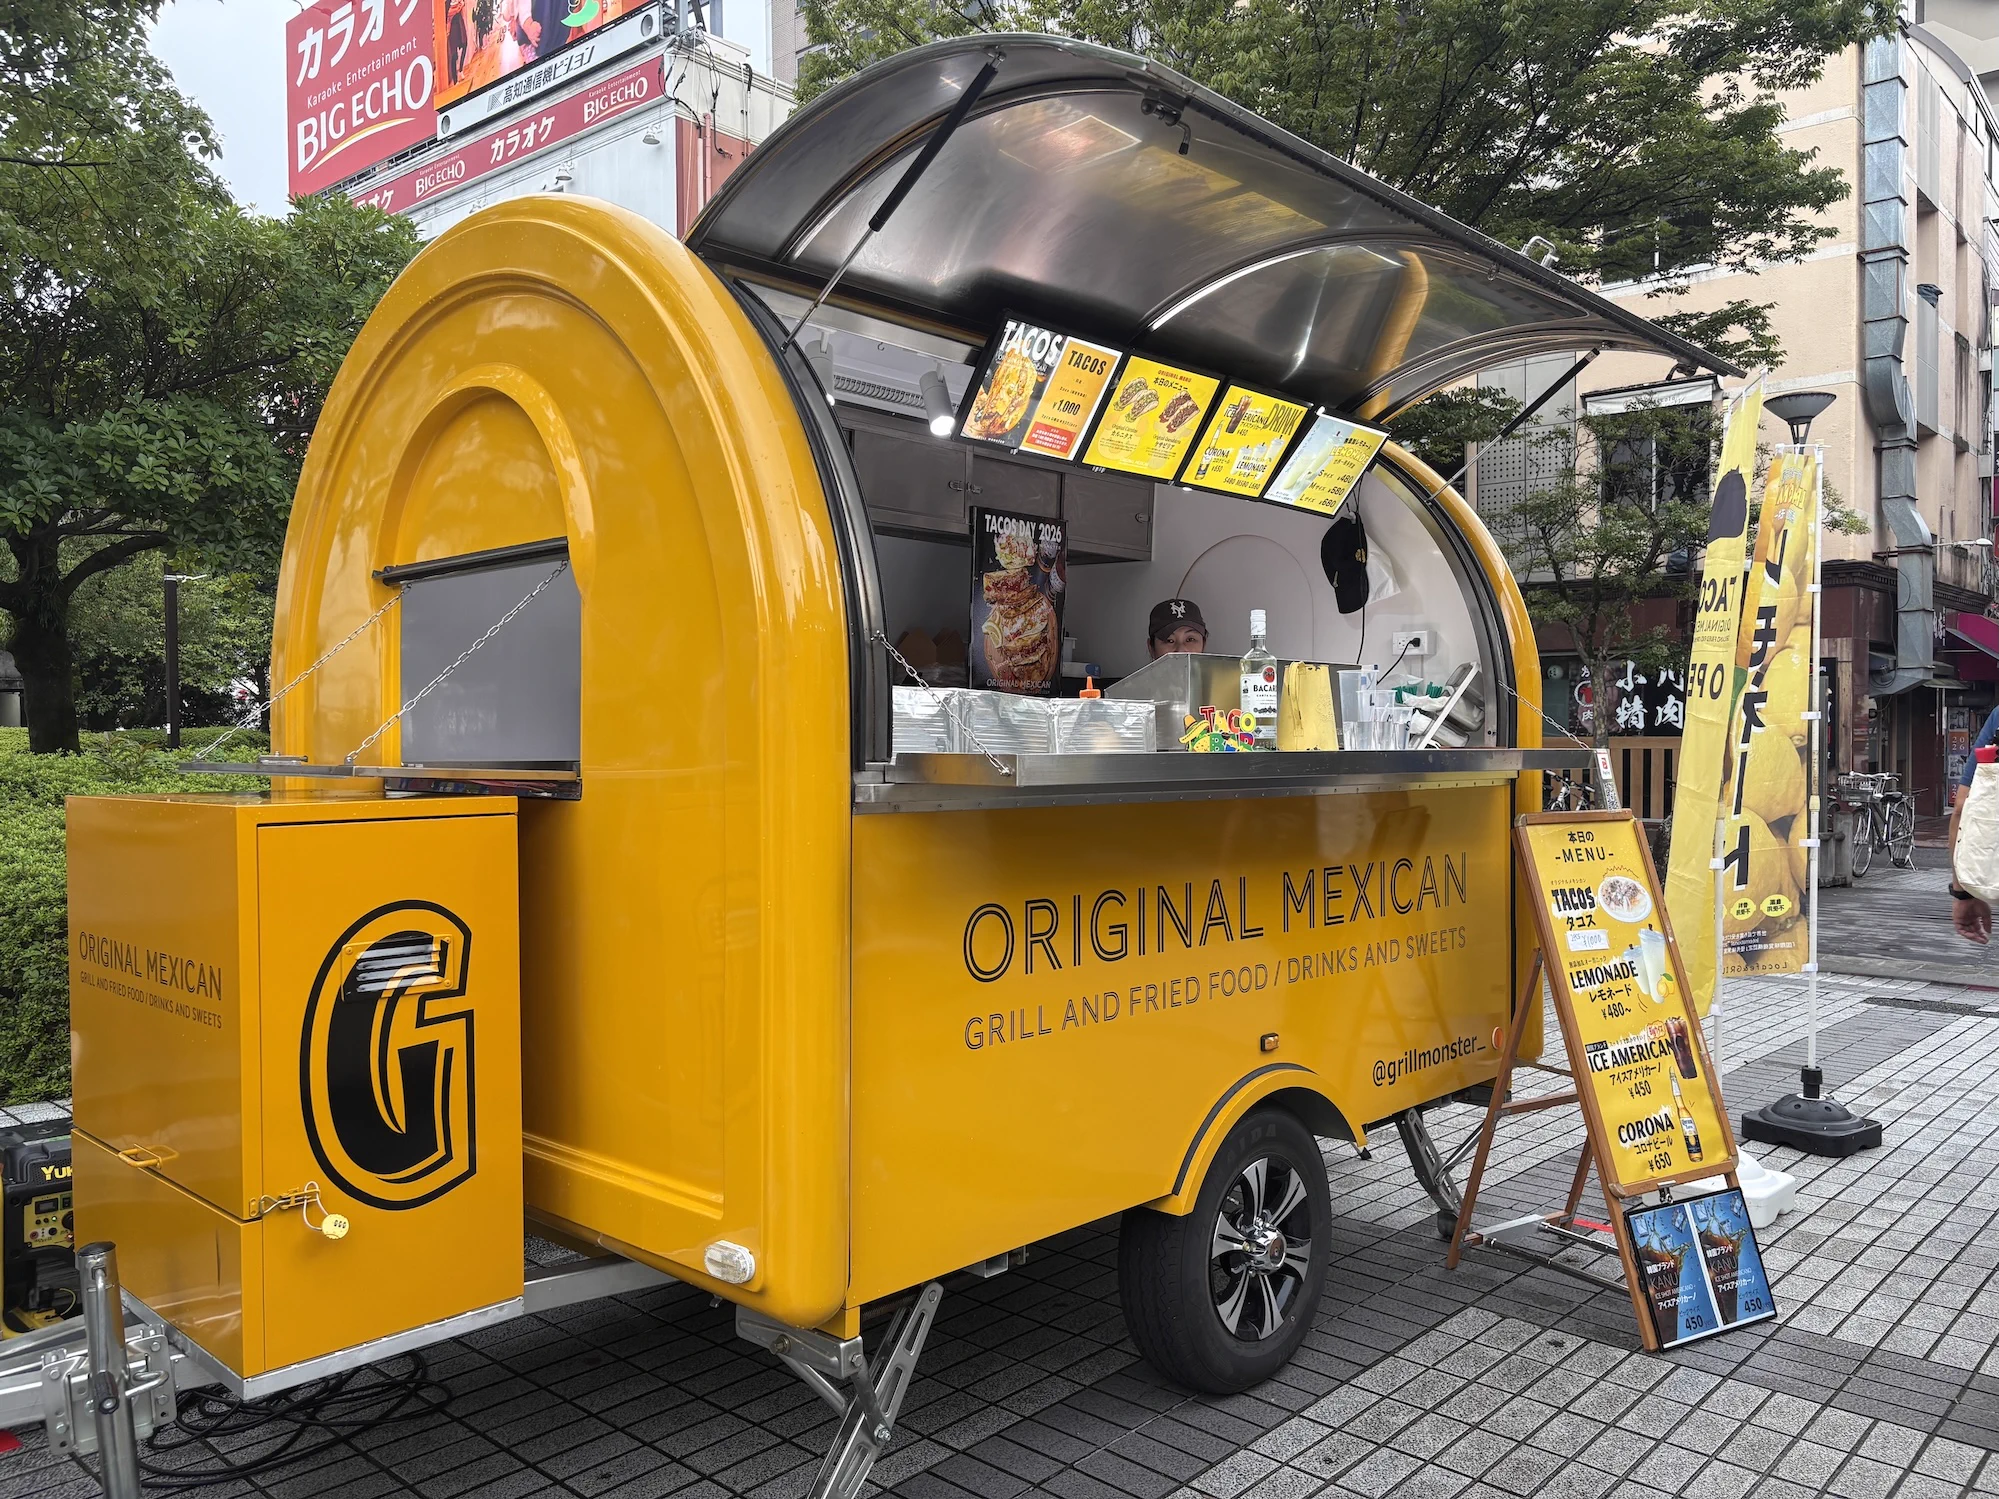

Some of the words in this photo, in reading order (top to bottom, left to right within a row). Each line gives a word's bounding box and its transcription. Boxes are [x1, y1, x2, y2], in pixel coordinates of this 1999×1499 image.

[307, 80, 342, 109] Karaoke
[346, 36, 417, 87] Entertainment
[503, 45, 595, 105] 高知通信機ビジョン
[608, 70, 641, 89] Entertainment
[583, 94, 609, 123] BIG
[610, 76, 648, 105] ECHO
[297, 103, 345, 173] BIG
[352, 55, 433, 128] ECHO
[490, 116, 555, 164] カラオケ
[415, 174, 434, 198] BIG
[436, 160, 465, 183] ECHO
[999, 320, 1063, 367] TACOS
[1067, 350, 1107, 375] TACOS
[1153, 377, 1188, 391] 本日のメニュー
[1263, 402, 1303, 436] DRINK
[1205, 446, 1230, 458] CORONA
[1330, 446, 1370, 465] LEMONADE
[1236, 461, 1268, 473] LEMONADE
[985, 514, 1017, 535] TACOS
[1019, 520, 1037, 539] DAY
[1038, 523, 1062, 543] 2026
[986, 678, 1019, 688] ORIGINAL
[1020, 680, 1051, 689] MEXICAN
[1199, 706, 1257, 734] TACO
[1615, 694, 1684, 730] 精肉
[1568, 831, 1594, 844] 本日の
[1551, 886, 1596, 912] TACOS
[963, 876, 1264, 983] ORIGINAL
[1283, 852, 1467, 933] MEXICAN
[1566, 914, 1596, 931] タコス
[80, 931, 142, 978] ORIGINAL
[146, 949, 222, 1001] MEXICAN
[1569, 960, 1639, 990] LEMONADE
[80, 970, 95, 987] GRILL
[97, 976, 108, 991] AND
[109, 980, 126, 997] FRIED
[127, 986, 144, 1003] FOOD
[149, 993, 174, 1013] DRINKS
[175, 1002, 190, 1018] AND
[192, 1007, 222, 1029] SWEETS
[964, 1005, 1052, 1050] GRILL
[1061, 991, 1120, 1031] AND
[1130, 976, 1200, 1016] FRIED
[1209, 963, 1268, 1000] FOOD
[1274, 960, 1281, 986] /
[1287, 946, 1358, 984] DRINKS
[1364, 938, 1400, 968] AND
[1406, 926, 1466, 959] SWEETS
[1589, 984, 1632, 1003] レモネード
[299, 899, 477, 1211] G
[1372, 1034, 1486, 1087] @grillmonster_
[1588, 1052, 1610, 1073] ICE
[1609, 1062, 1662, 1086] アイスアメリカーノ
[1628, 1080, 1652, 1099] ¥450
[1618, 1113, 1675, 1144] CORONA
[1634, 1135, 1673, 1155] コロナビール
[1648, 1151, 1672, 1172] ¥650
[1706, 1244, 1733, 1258] 韓国ブランド
[1646, 1259, 1675, 1274] 韓国ブランド
[1710, 1256, 1737, 1273] KANU
[1650, 1272, 1679, 1290] KANU
[1717, 1278, 1755, 1293] アイスアメリカーノ
[1657, 1291, 1696, 1310] アイスアメリカーノ
[1744, 1298, 1762, 1313] 450
[1685, 1315, 1703, 1331] 450
